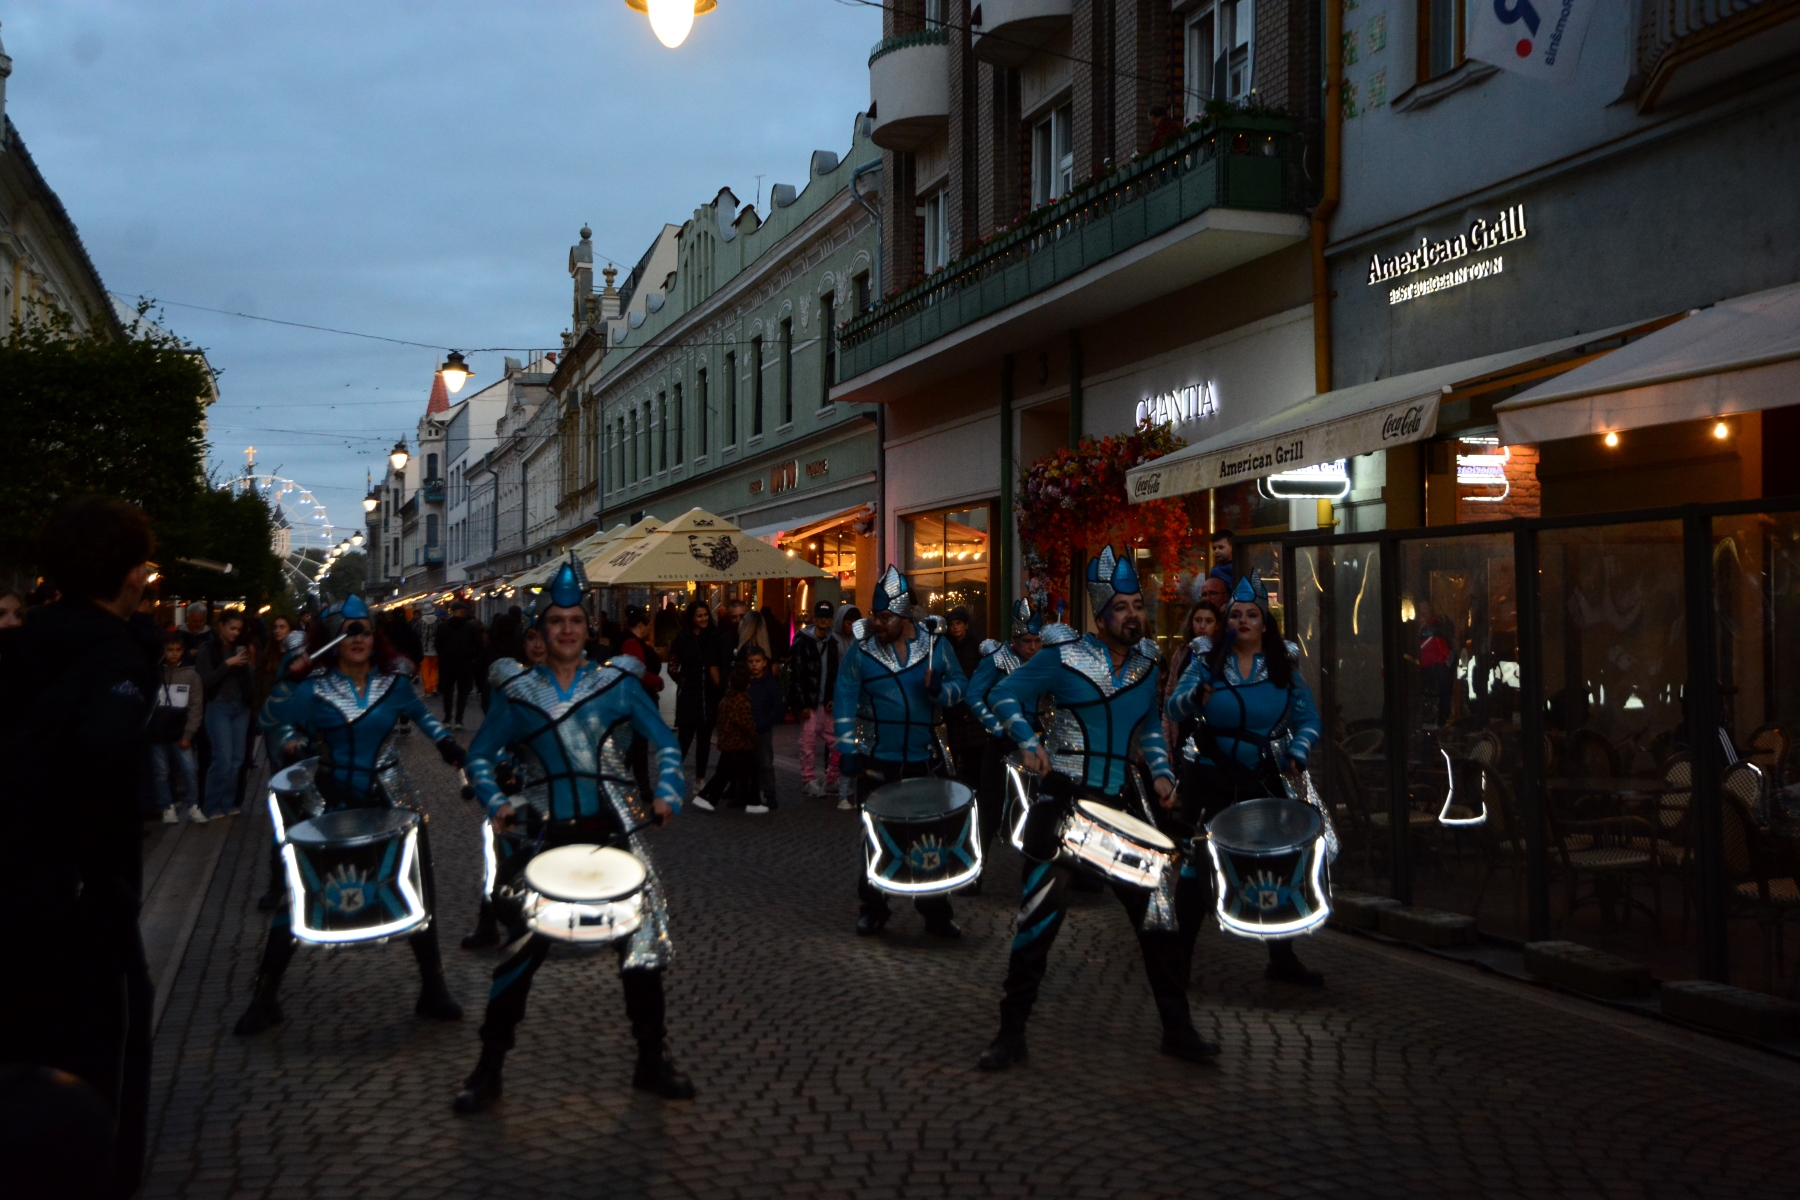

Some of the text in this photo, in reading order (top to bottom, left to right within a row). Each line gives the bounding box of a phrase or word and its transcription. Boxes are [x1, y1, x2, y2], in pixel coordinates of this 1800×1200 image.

[1367, 203, 1527, 285] American Grill
[1389, 283, 1413, 305] BEST
[1413, 273, 1454, 297] BURGER
[1467, 256, 1503, 280] TOWN
[1135, 380, 1217, 433] CHANTIA
[1220, 440, 1304, 478] American Grill
